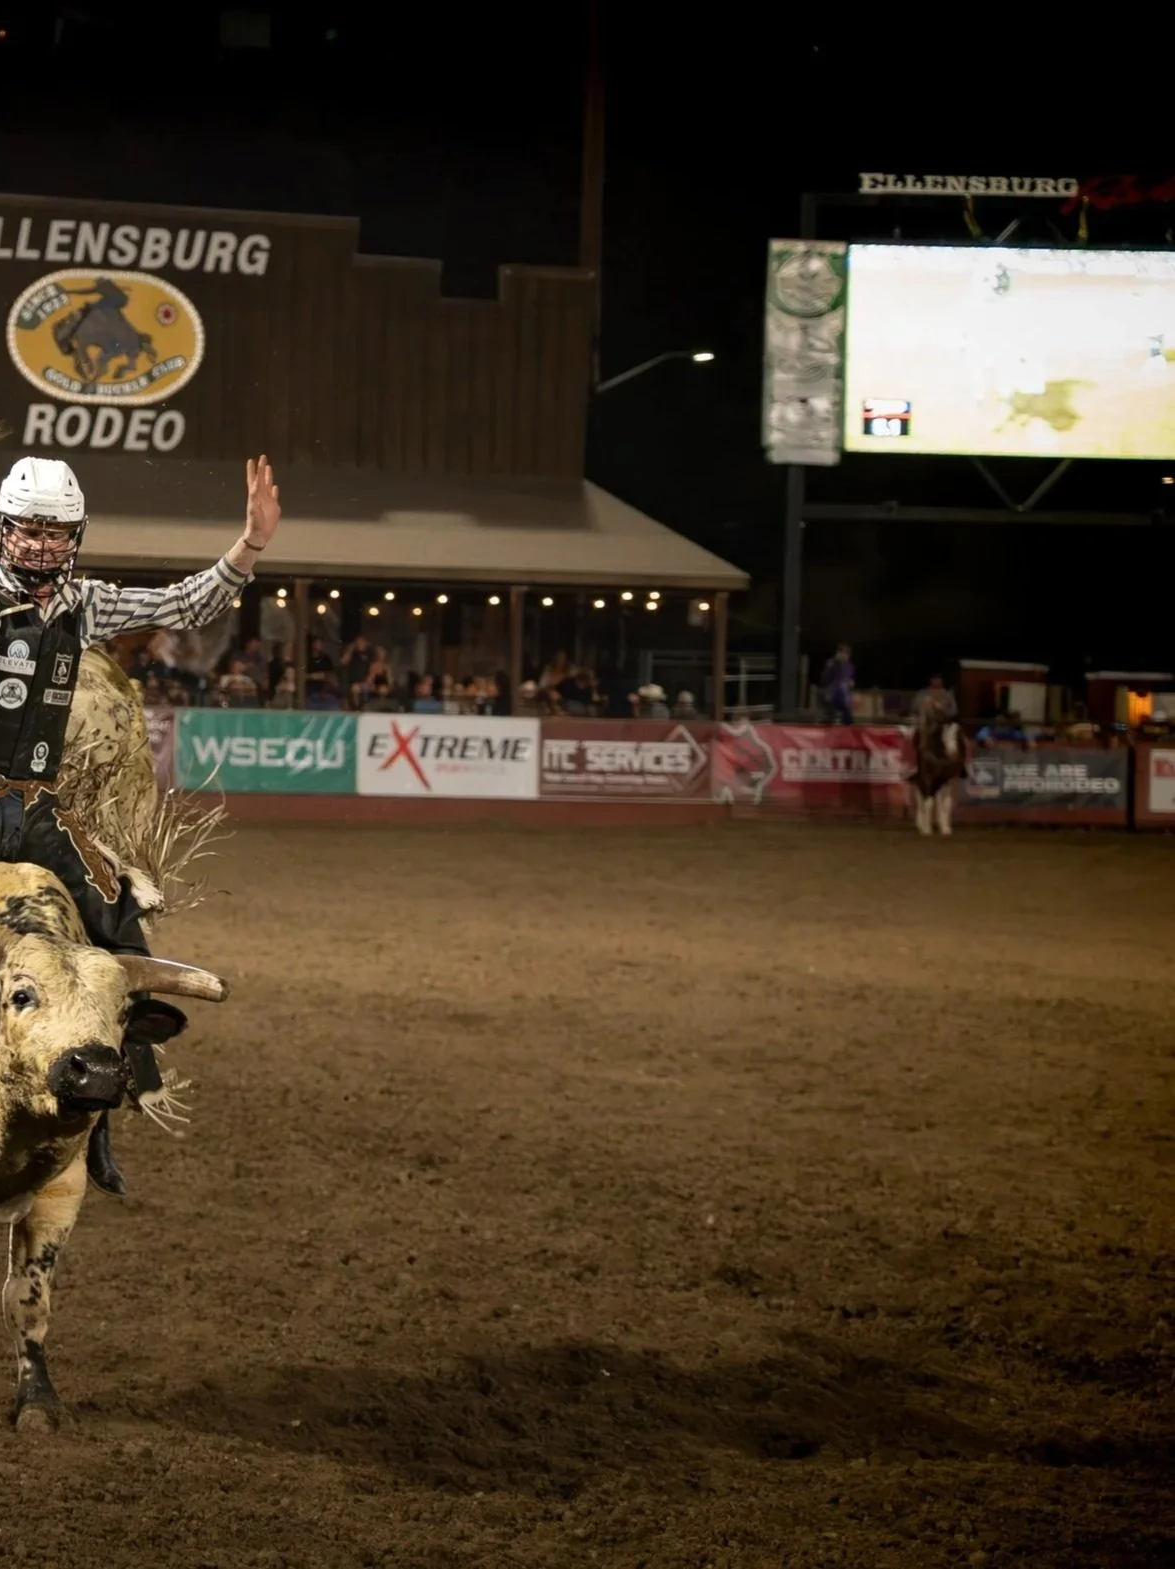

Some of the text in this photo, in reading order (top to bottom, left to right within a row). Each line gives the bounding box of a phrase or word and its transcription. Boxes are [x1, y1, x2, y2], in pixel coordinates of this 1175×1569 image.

[859, 172, 1079, 196] ELLENSBURG
[22, 402, 186, 453] RODEO
[192, 735, 346, 769] WSECU
[368, 720, 533, 791] EXTREME
[582, 741, 692, 773] SERVICES
[1002, 763, 1089, 777] WE ARE
